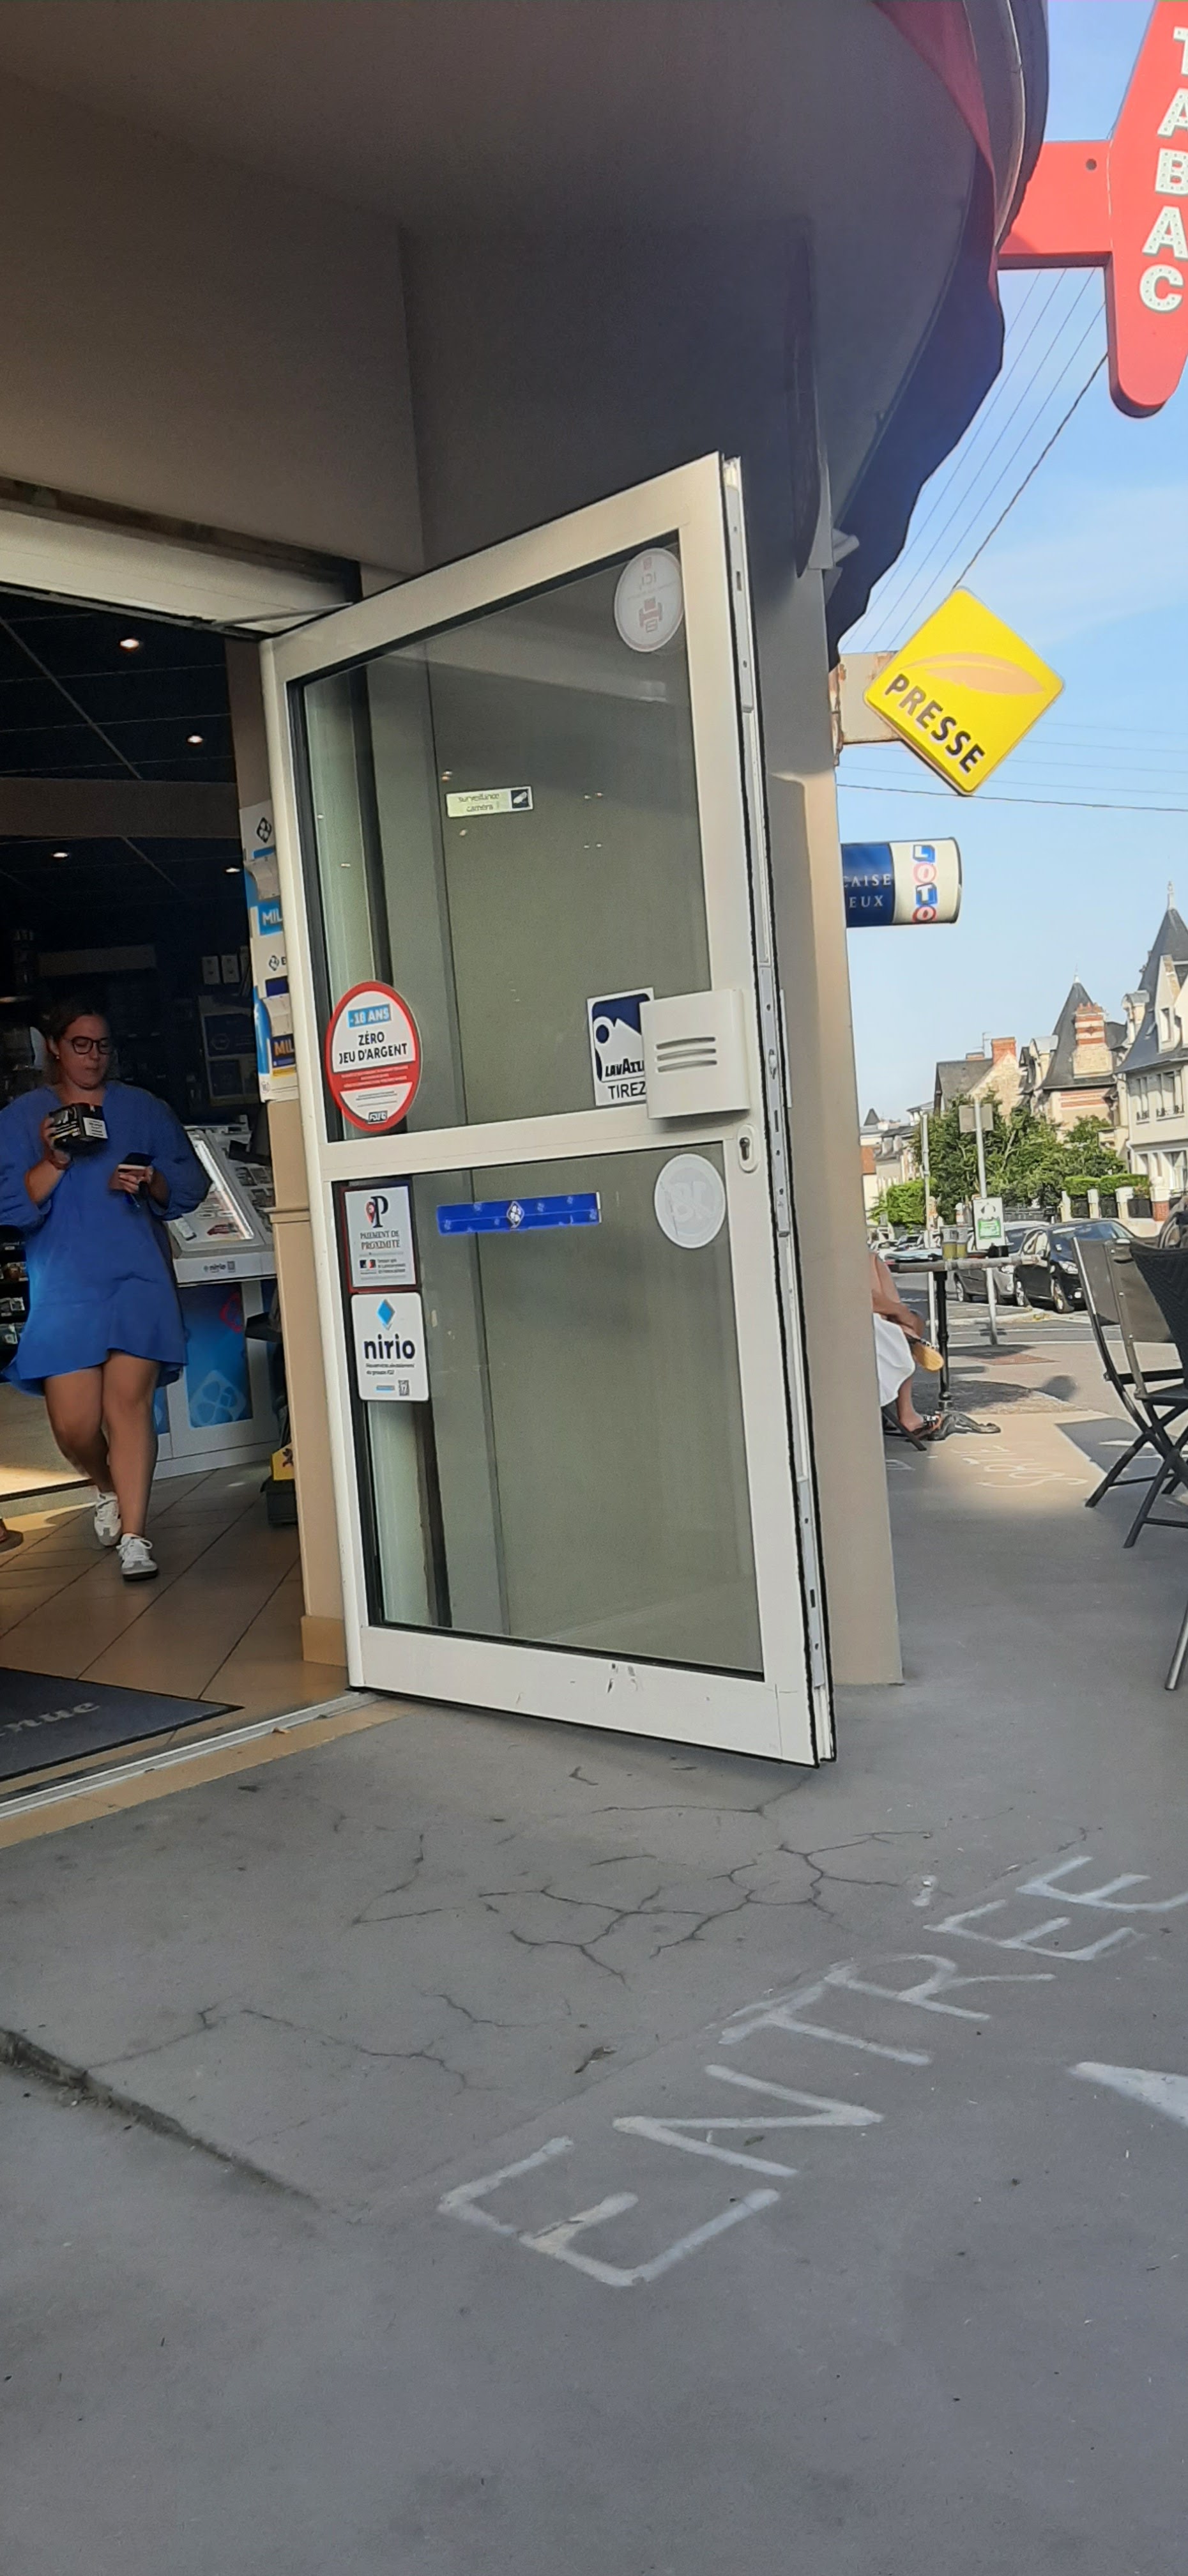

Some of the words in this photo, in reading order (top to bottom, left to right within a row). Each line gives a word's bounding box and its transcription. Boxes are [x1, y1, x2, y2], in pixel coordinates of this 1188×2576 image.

[884, 673, 986, 774] PRESSE
[913, 845, 937, 923] LOTO
[367, 1007, 390, 1022] ANS
[358, 1031, 385, 1046] ZÉRO
[339, 1051, 355, 1064] JEU
[358, 1043, 407, 1061] D'ARGENT
[607, 1081, 646, 1100] TIREZ
[364, 1333, 416, 1359] nirio
[0, 1702, 100, 1737] nue
[438, 1855, 1188, 2287] ENTRÉE
